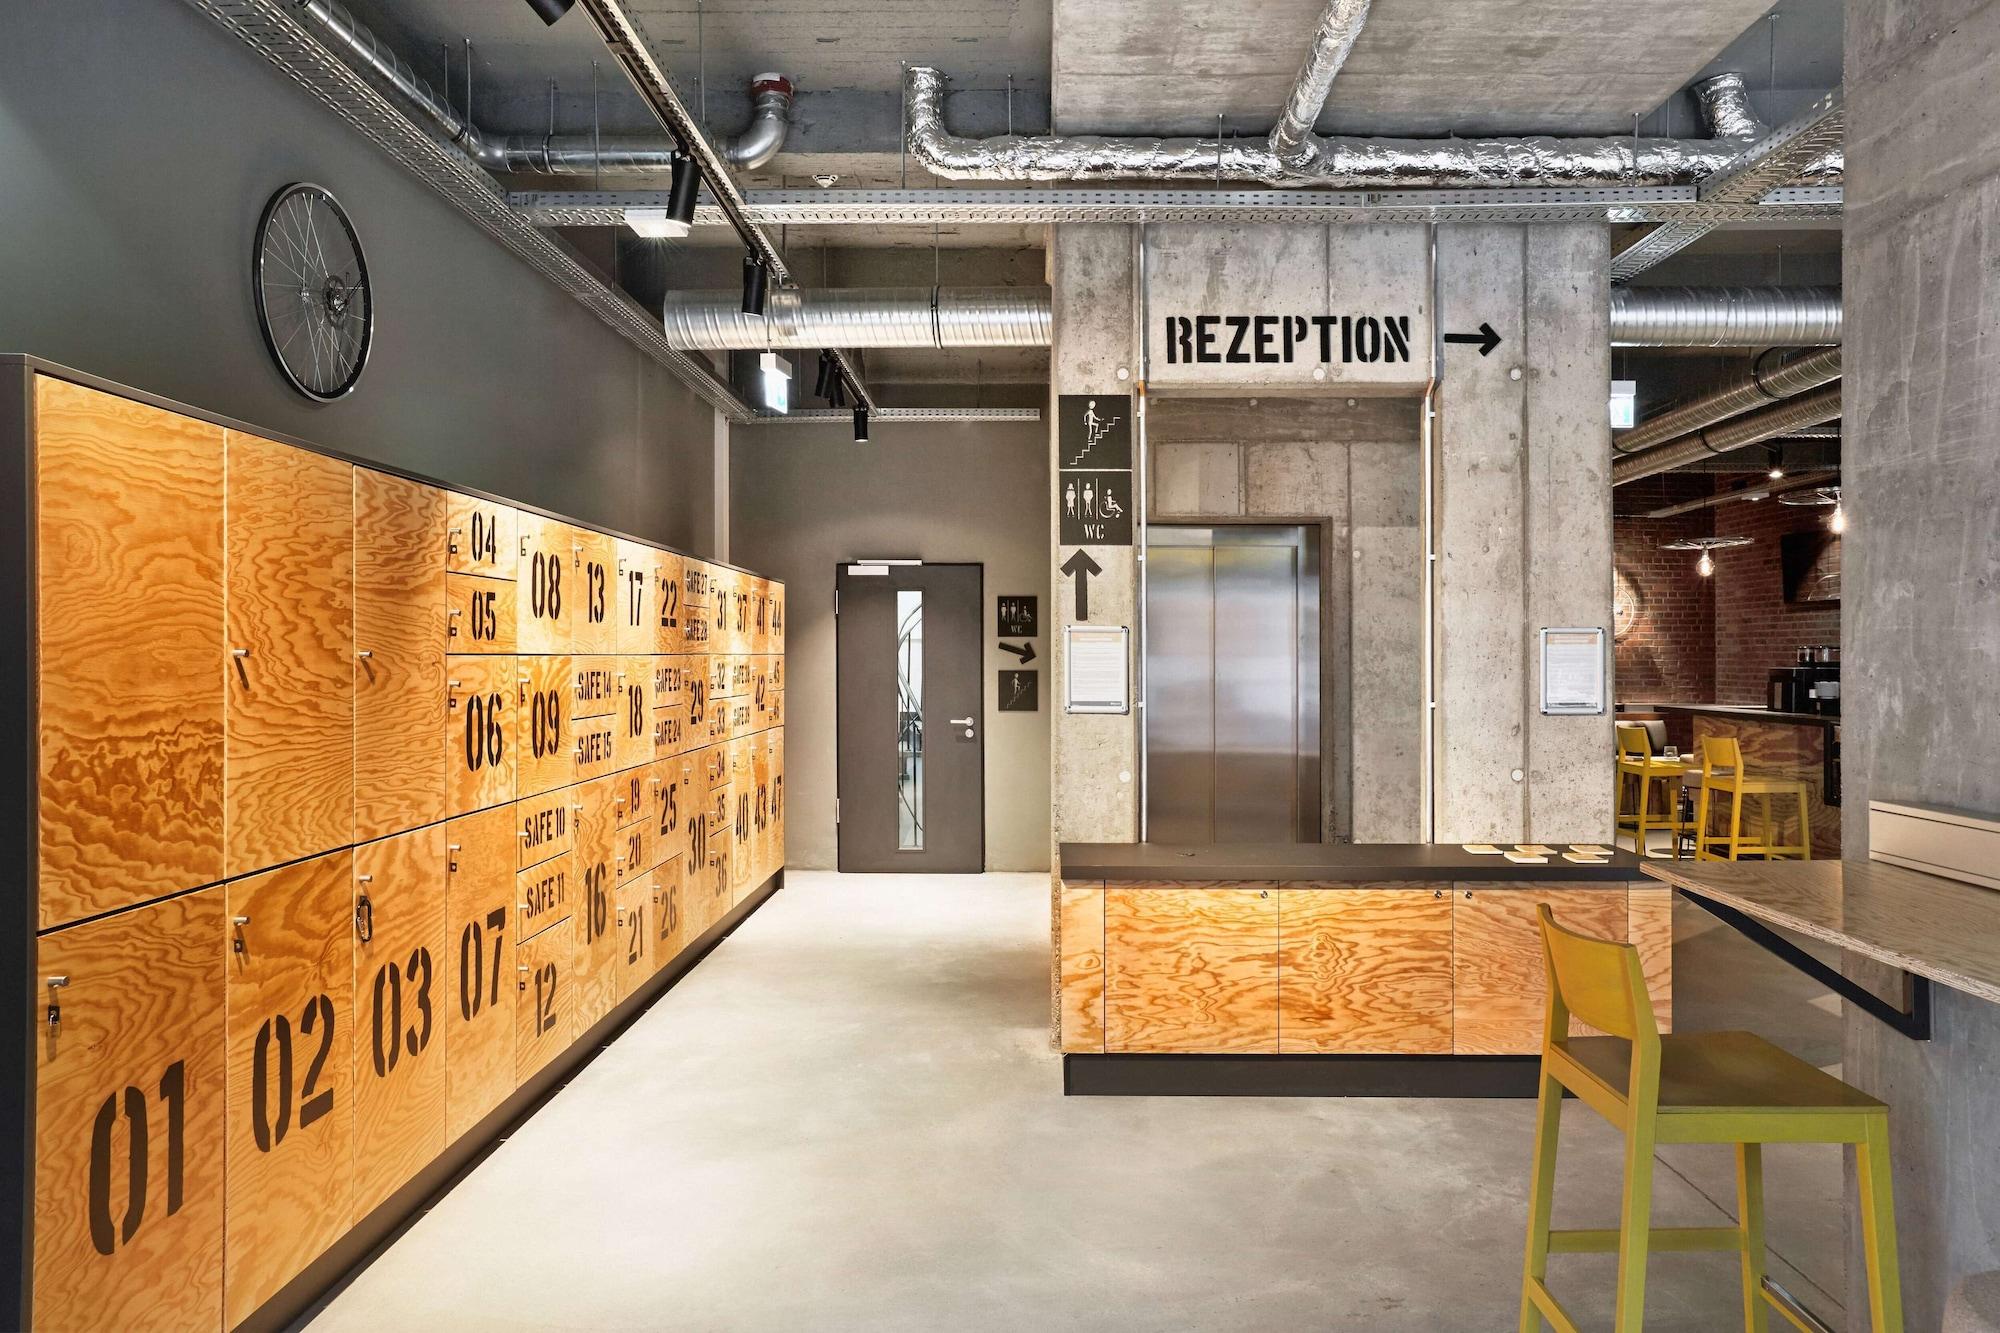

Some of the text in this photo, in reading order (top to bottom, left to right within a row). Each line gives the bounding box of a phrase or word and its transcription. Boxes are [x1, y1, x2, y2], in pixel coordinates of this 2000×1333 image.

[1166, 316, 1409, 364] REZEPTION
[471, 511, 496, 564] 04
[1083, 523, 1105, 540] WC
[531, 551, 561, 620] 08
[587, 562, 605, 623] 13
[629, 571, 643, 627] 17
[661, 578, 677, 628] 22
[686, 570, 708, 595] SAFE 27
[471, 591, 496, 641] 05
[717, 590, 727, 631] 31
[737, 594, 747, 633] 37
[756, 597, 765, 635] 41
[772, 600, 782, 636] 44
[1010, 624, 1023, 634] WC
[578, 671, 612, 701] SAFE 14
[656, 668, 681, 693] SAFE 23
[717, 663, 725, 690] 32
[755, 674, 765, 712] 42
[531, 690, 560, 760] 09
[628, 685, 643, 738] 18
[690, 679, 704, 725] 29
[717, 706, 725, 735] 33
[466, 692, 503, 772] 06
[578, 732, 612, 765] SAFE 15
[656, 718, 681, 747] SAFE 24
[716, 750, 725, 779] 34
[630, 777, 640, 815] 19
[661, 783, 677, 836] 25
[716, 794, 725, 823] 35
[735, 792, 749, 845] 40
[754, 783, 767, 834] 43
[771, 775, 782, 822] 47
[524, 806, 565, 849] SAFE 10
[688, 813, 706, 876] 30
[629, 832, 641, 871] 20
[715, 852, 727, 898] 36
[526, 872, 565, 919] SAFE 11
[585, 862, 607, 946] 16
[661, 885, 677, 940] 26
[628, 905, 643, 965] 21
[460, 906, 506, 1021] 07
[372, 946, 432, 1078] 03
[534, 963, 557, 1038] 12
[252, 993, 335, 1153] 02
[89, 1059, 185, 1256] 01
